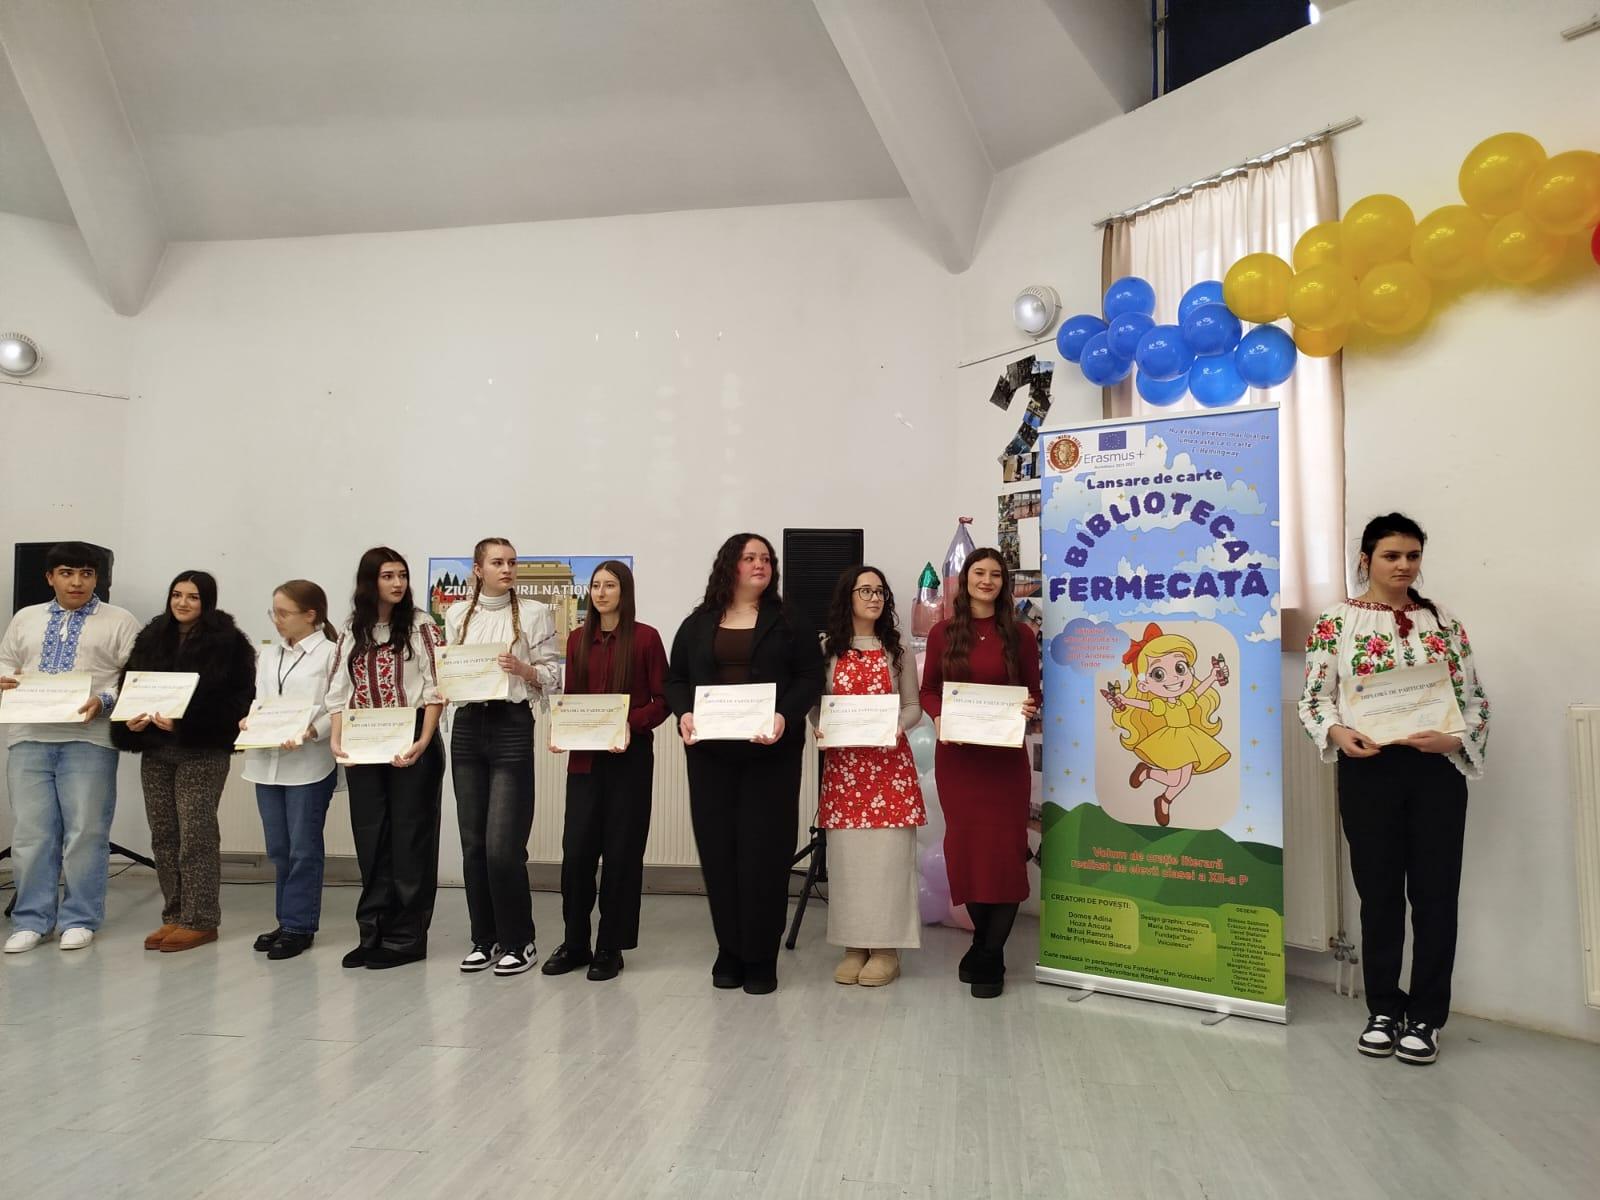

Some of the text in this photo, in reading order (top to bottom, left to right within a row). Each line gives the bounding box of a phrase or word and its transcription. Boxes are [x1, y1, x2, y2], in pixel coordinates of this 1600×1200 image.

[1087, 469, 1223, 490] Lansare de carte
[1064, 491, 1250, 568] BIBLIOTECA
[445, 585, 474, 595] ZIUA
[1049, 562, 1269, 602] FERMECATĂ
[1092, 847, 1127, 859] Volum
[1130, 850, 1144, 861] de
[1113, 862, 1127, 873] de
[1199, 873, 1206, 882] a
[1239, 874, 1248, 885] P
[1051, 893, 1086, 903] CREATORI
